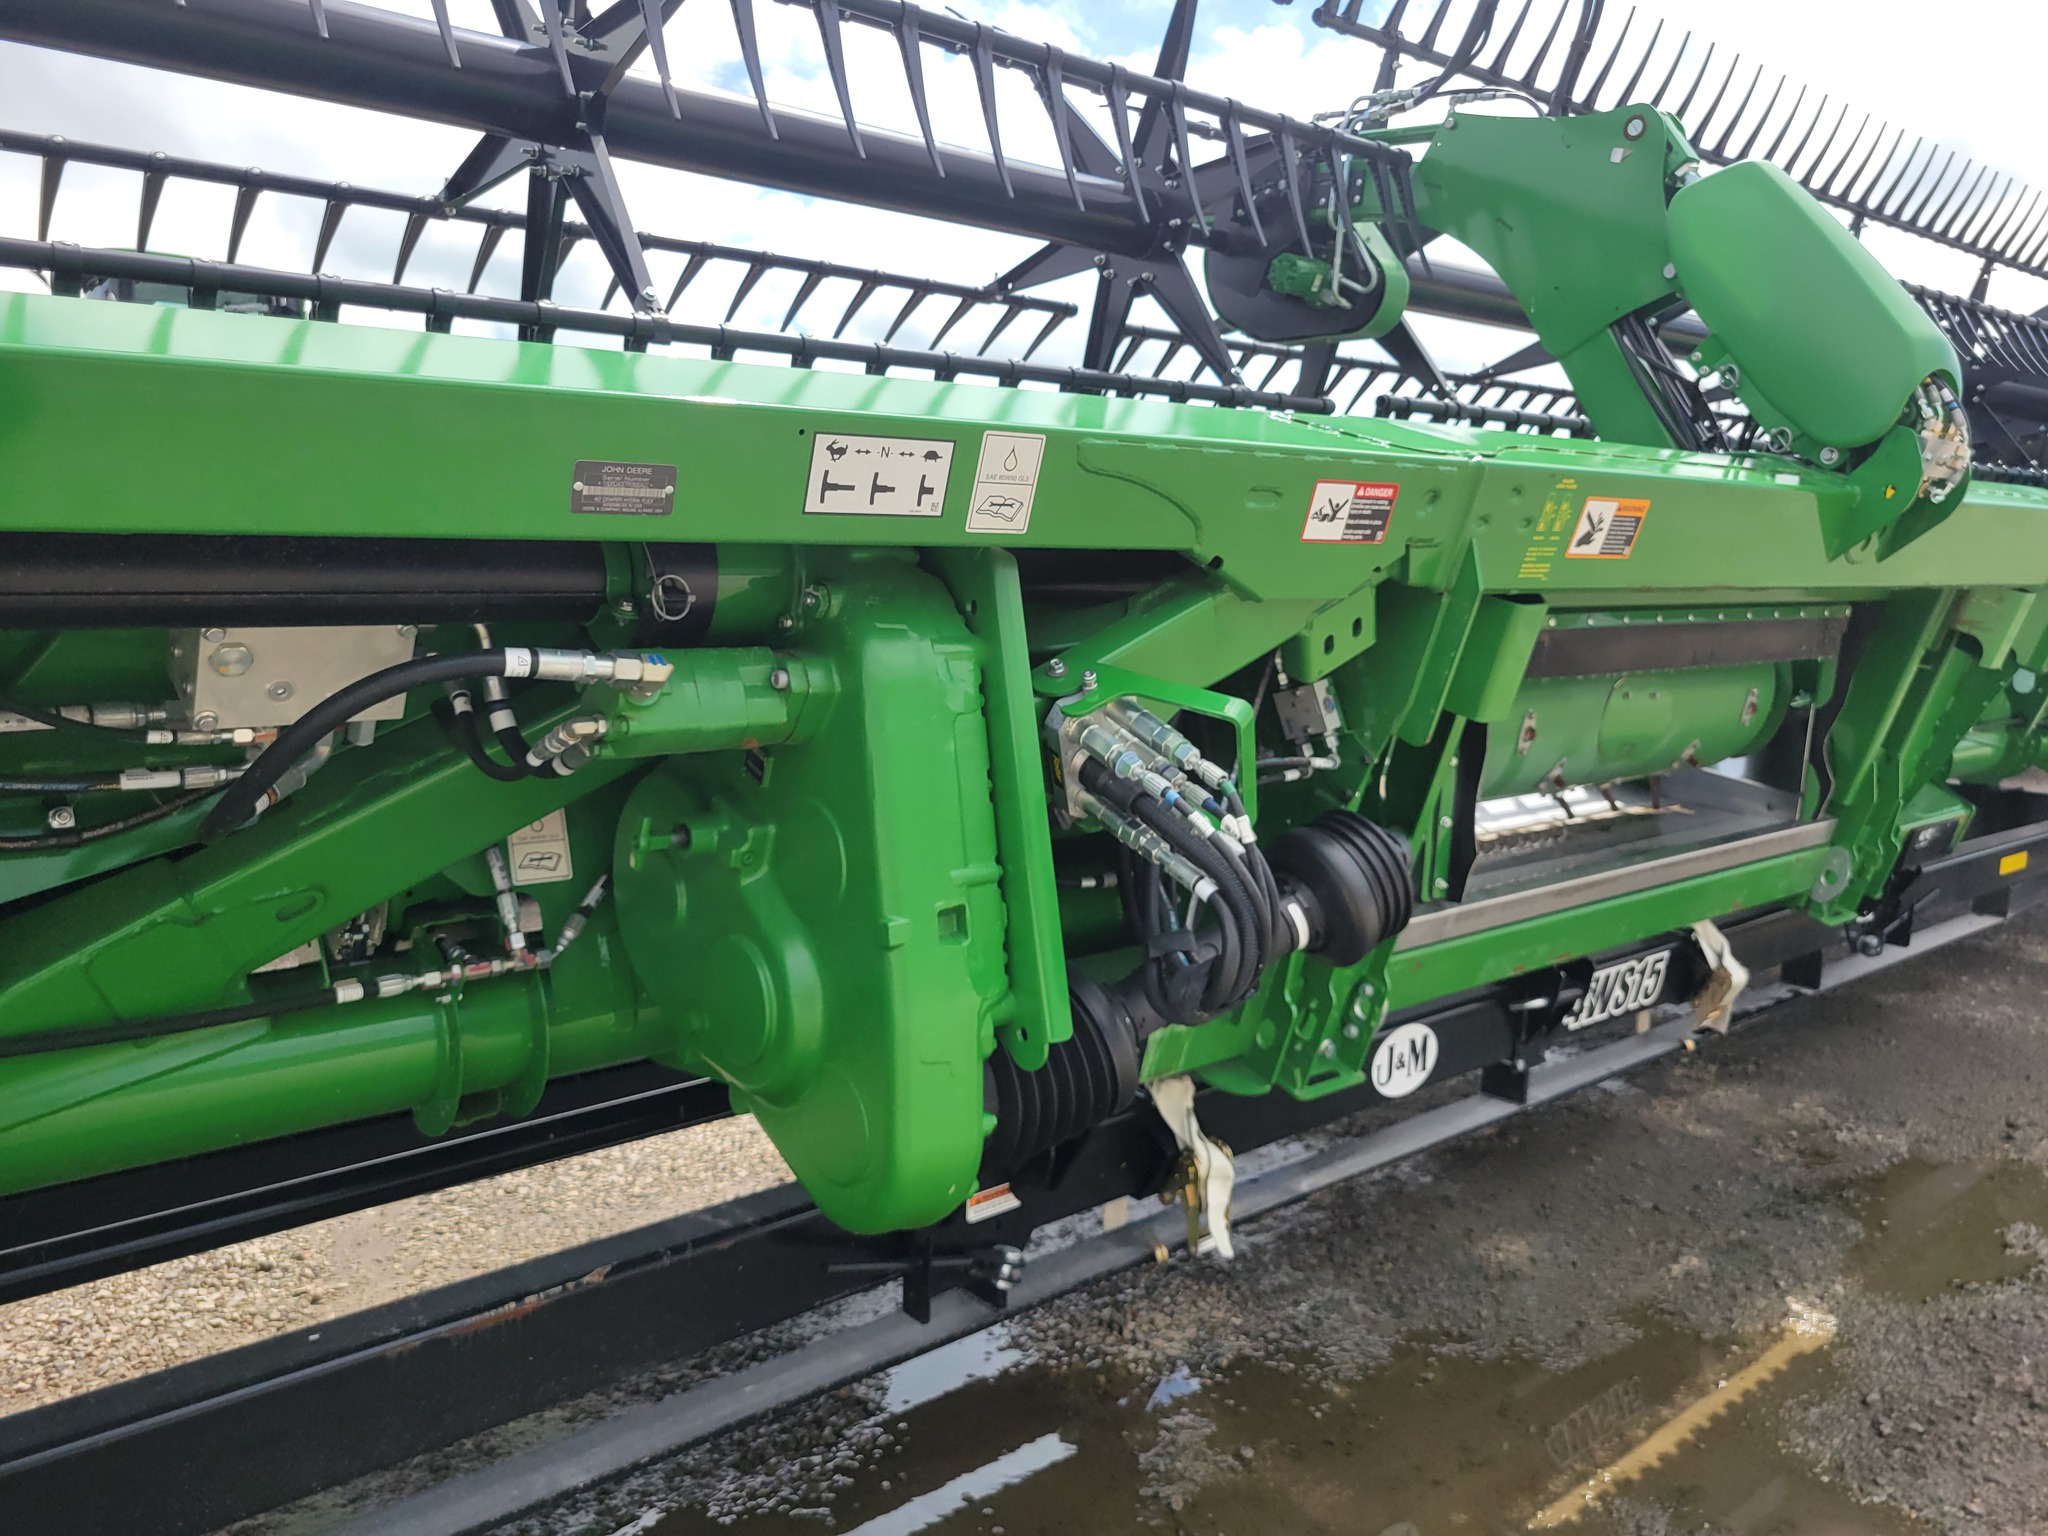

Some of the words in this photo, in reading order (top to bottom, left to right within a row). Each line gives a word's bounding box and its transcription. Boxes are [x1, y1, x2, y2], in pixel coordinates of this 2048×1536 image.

[601, 466, 624, 474] JOHN
[626, 466, 653, 475] DEERE
[985, 473, 997, 481] SAE
[1364, 487, 1394, 498] DANGER
[1376, 1032, 1430, 1087] J&M
